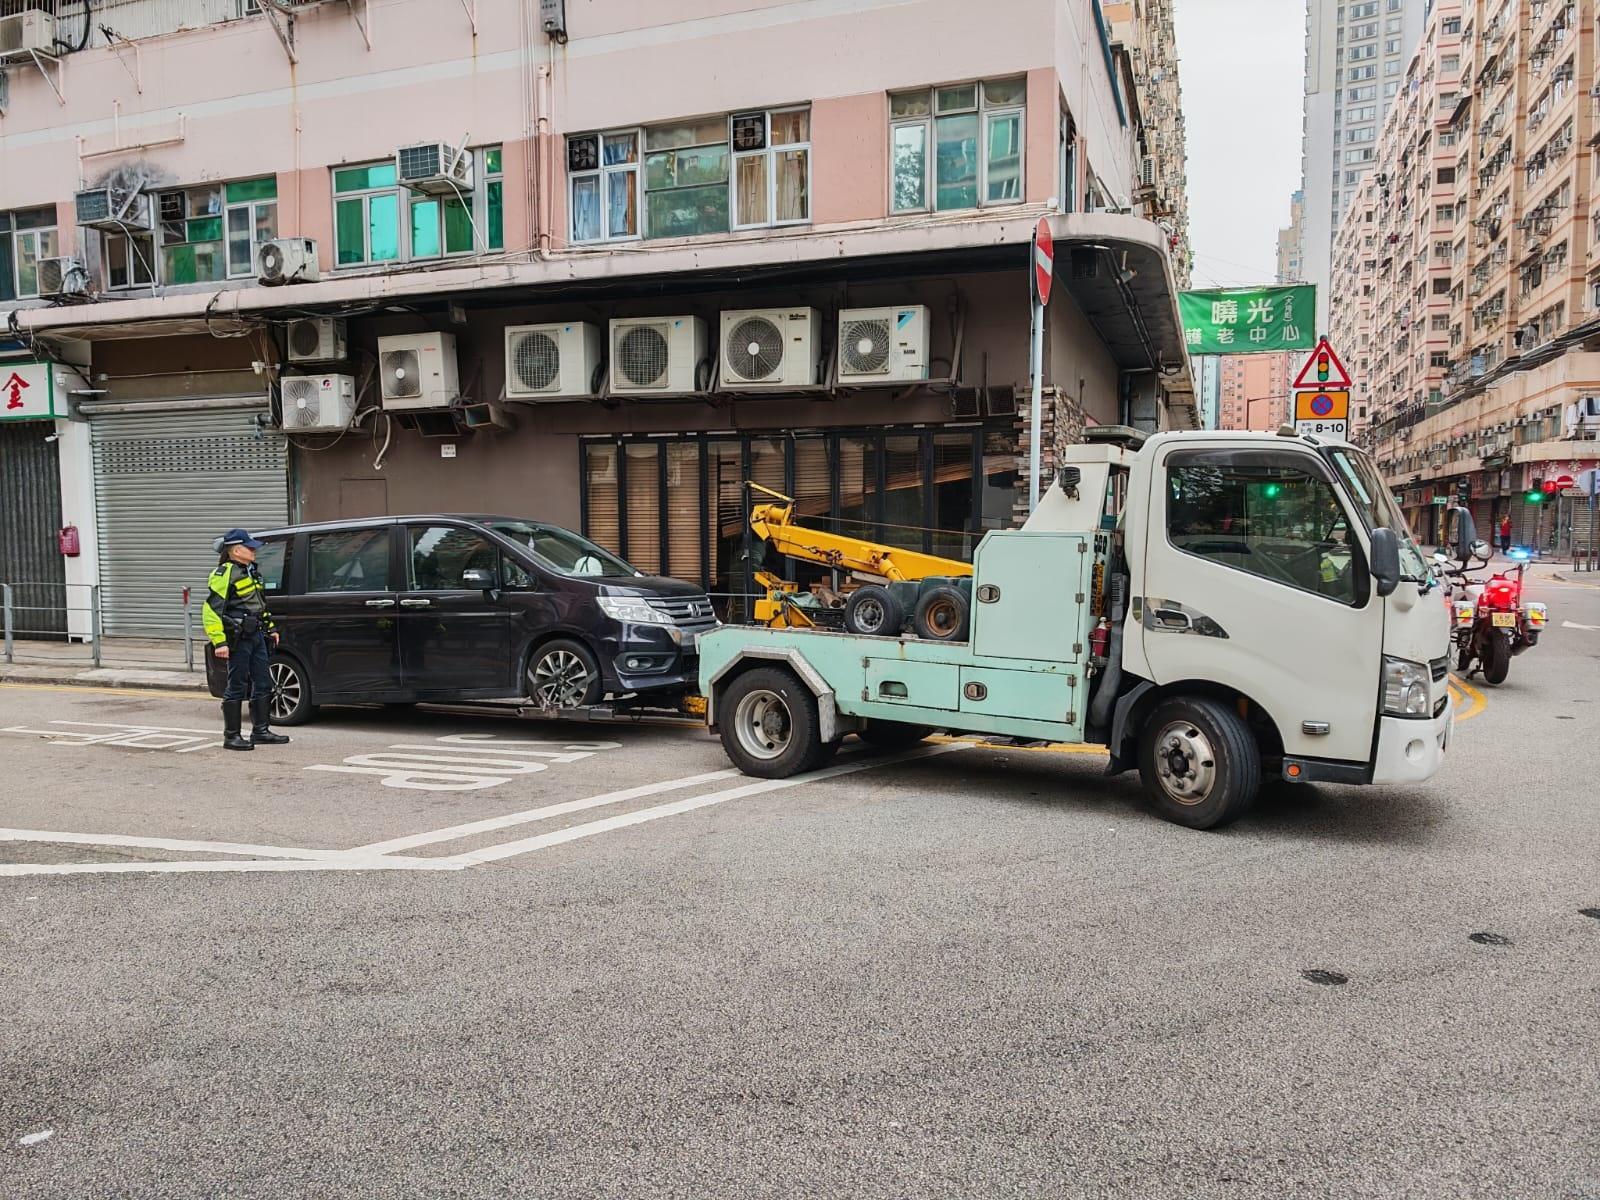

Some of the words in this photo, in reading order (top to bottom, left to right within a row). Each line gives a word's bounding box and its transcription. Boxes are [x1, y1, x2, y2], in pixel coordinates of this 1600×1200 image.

[1211, 298, 1274, 325] 曉光
[1185, 325, 1299, 344] 護老中心
[1, 372, 30, 410] 金
[1316, 423, 1344, 432] 8-10
[302, 733, 623, 790] STOP
